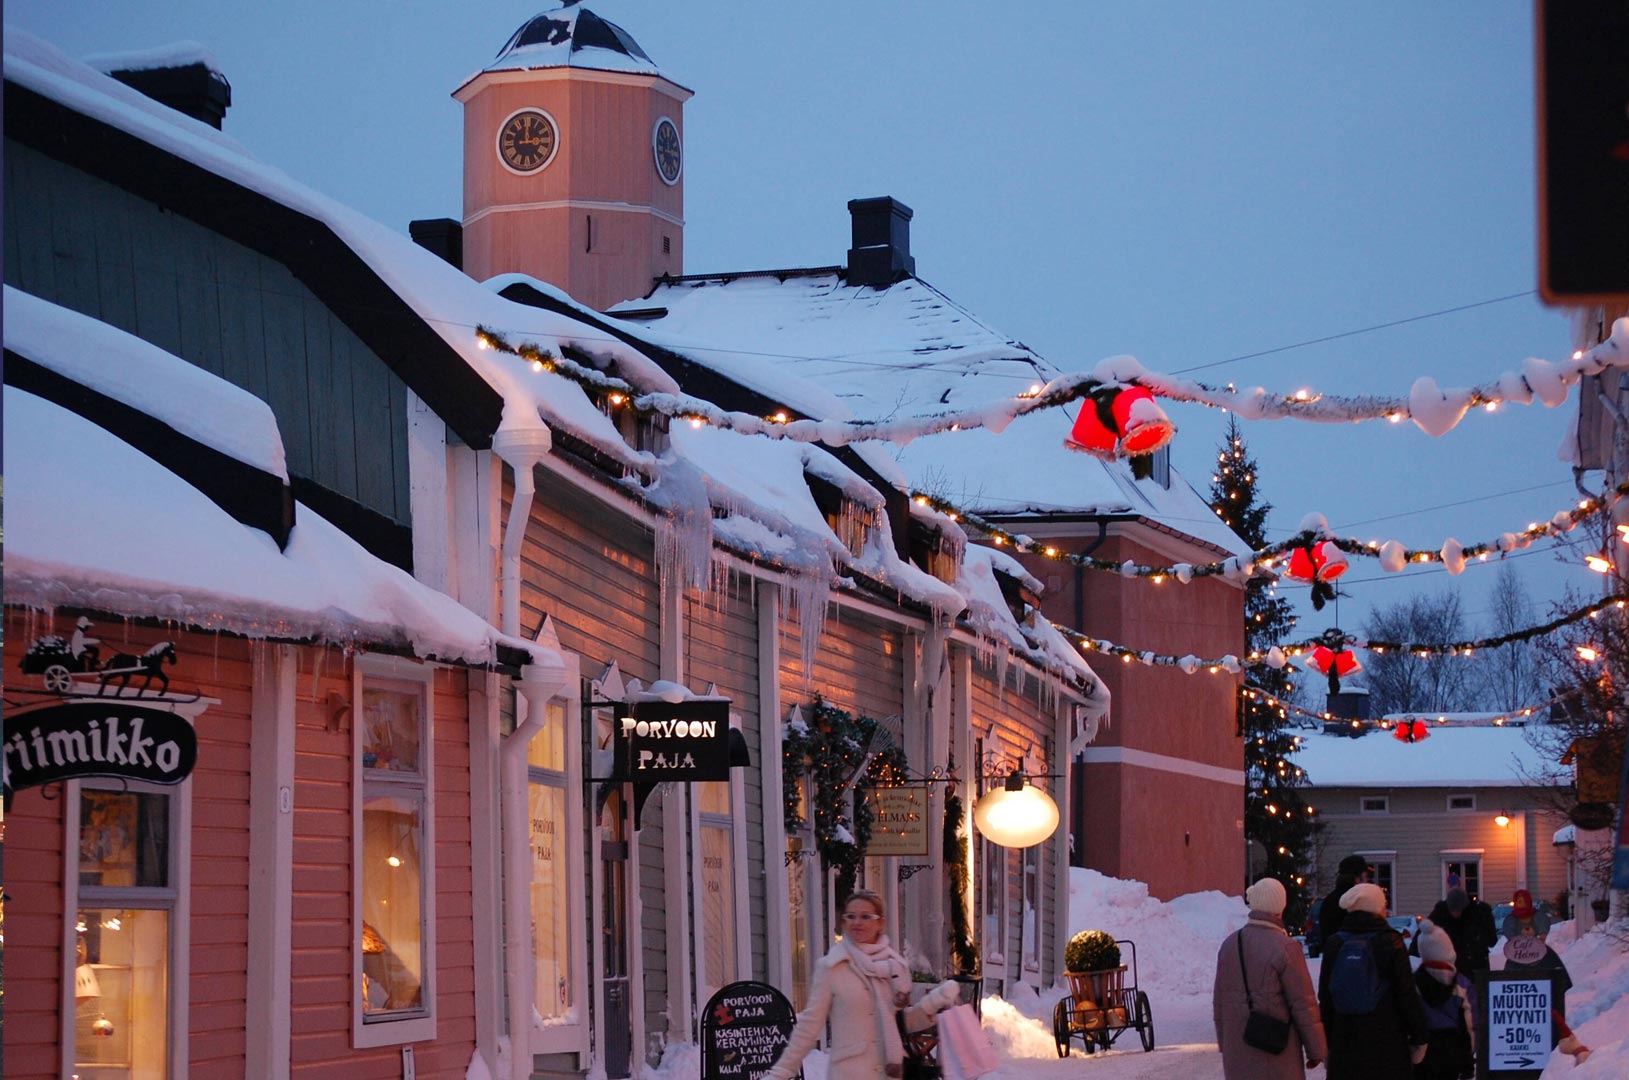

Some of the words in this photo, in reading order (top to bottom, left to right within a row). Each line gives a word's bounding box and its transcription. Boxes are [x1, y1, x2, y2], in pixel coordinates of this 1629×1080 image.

[620, 718, 717, 739] PORVOON
[637, 750, 696, 770] PAJA
[723, 994, 772, 1007] PORVOON
[1493, 994, 1546, 1009] MUUTTO
[735, 1007, 765, 1018] PAJA
[1493, 1010, 1546, 1025] MYYNTI
[1498, 1027, 1541, 1044] -50%
